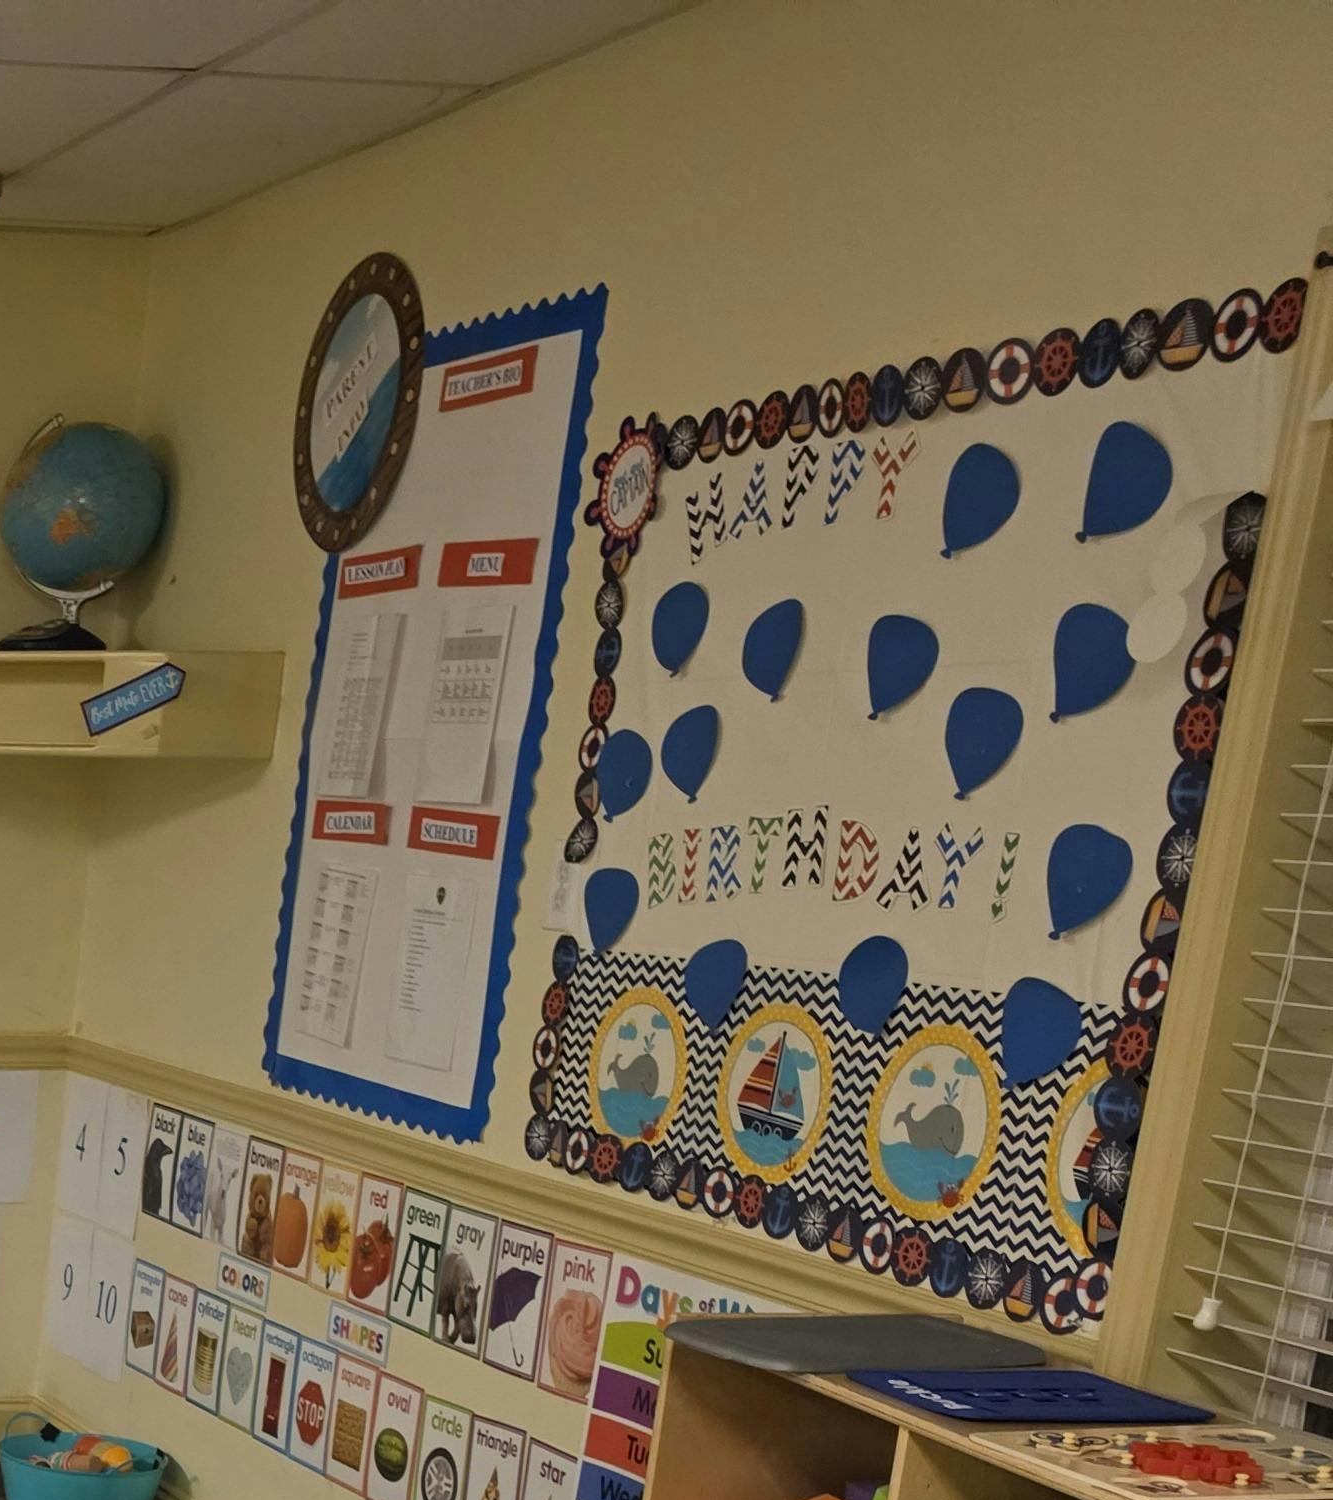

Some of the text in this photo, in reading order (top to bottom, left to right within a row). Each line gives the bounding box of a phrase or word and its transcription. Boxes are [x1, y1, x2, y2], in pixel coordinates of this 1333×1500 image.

[685, 428, 921, 566] HAPPY
[139, 676, 168, 703] EVER
[325, 813, 374, 832] CALENDAR
[423, 822, 477, 846] SCHEDULE
[187, 1123, 206, 1147] blue
[75, 1123, 88, 1161] 4
[114, 1137, 129, 1177] 5
[250, 1146, 280, 1172] brown
[285, 1161, 318, 1188] orange
[369, 1189, 389, 1210] red
[405, 1202, 441, 1231] green
[455, 1219, 485, 1250] gray
[500, 1235, 545, 1267] purple
[221, 1263, 265, 1298] COLORS
[562, 1255, 596, 1283] pink
[62, 1263, 74, 1301] 9
[95, 1280, 118, 1325] 10
[168, 1287, 189, 1308] cone
[197, 1300, 226, 1323] cylinder
[232, 1315, 259, 1339] heart
[332, 1315, 384, 1354] SHAPES
[265, 1331, 296, 1356] rectangle
[301, 1349, 334, 1373] octagon
[340, 1366, 372, 1392] square
[296, 1398, 326, 1430] STOP
[387, 1390, 412, 1415] oval
[431, 1410, 464, 1440] circle
[476, 1428, 519, 1460] triangle
[539, 1459, 567, 1487] star
